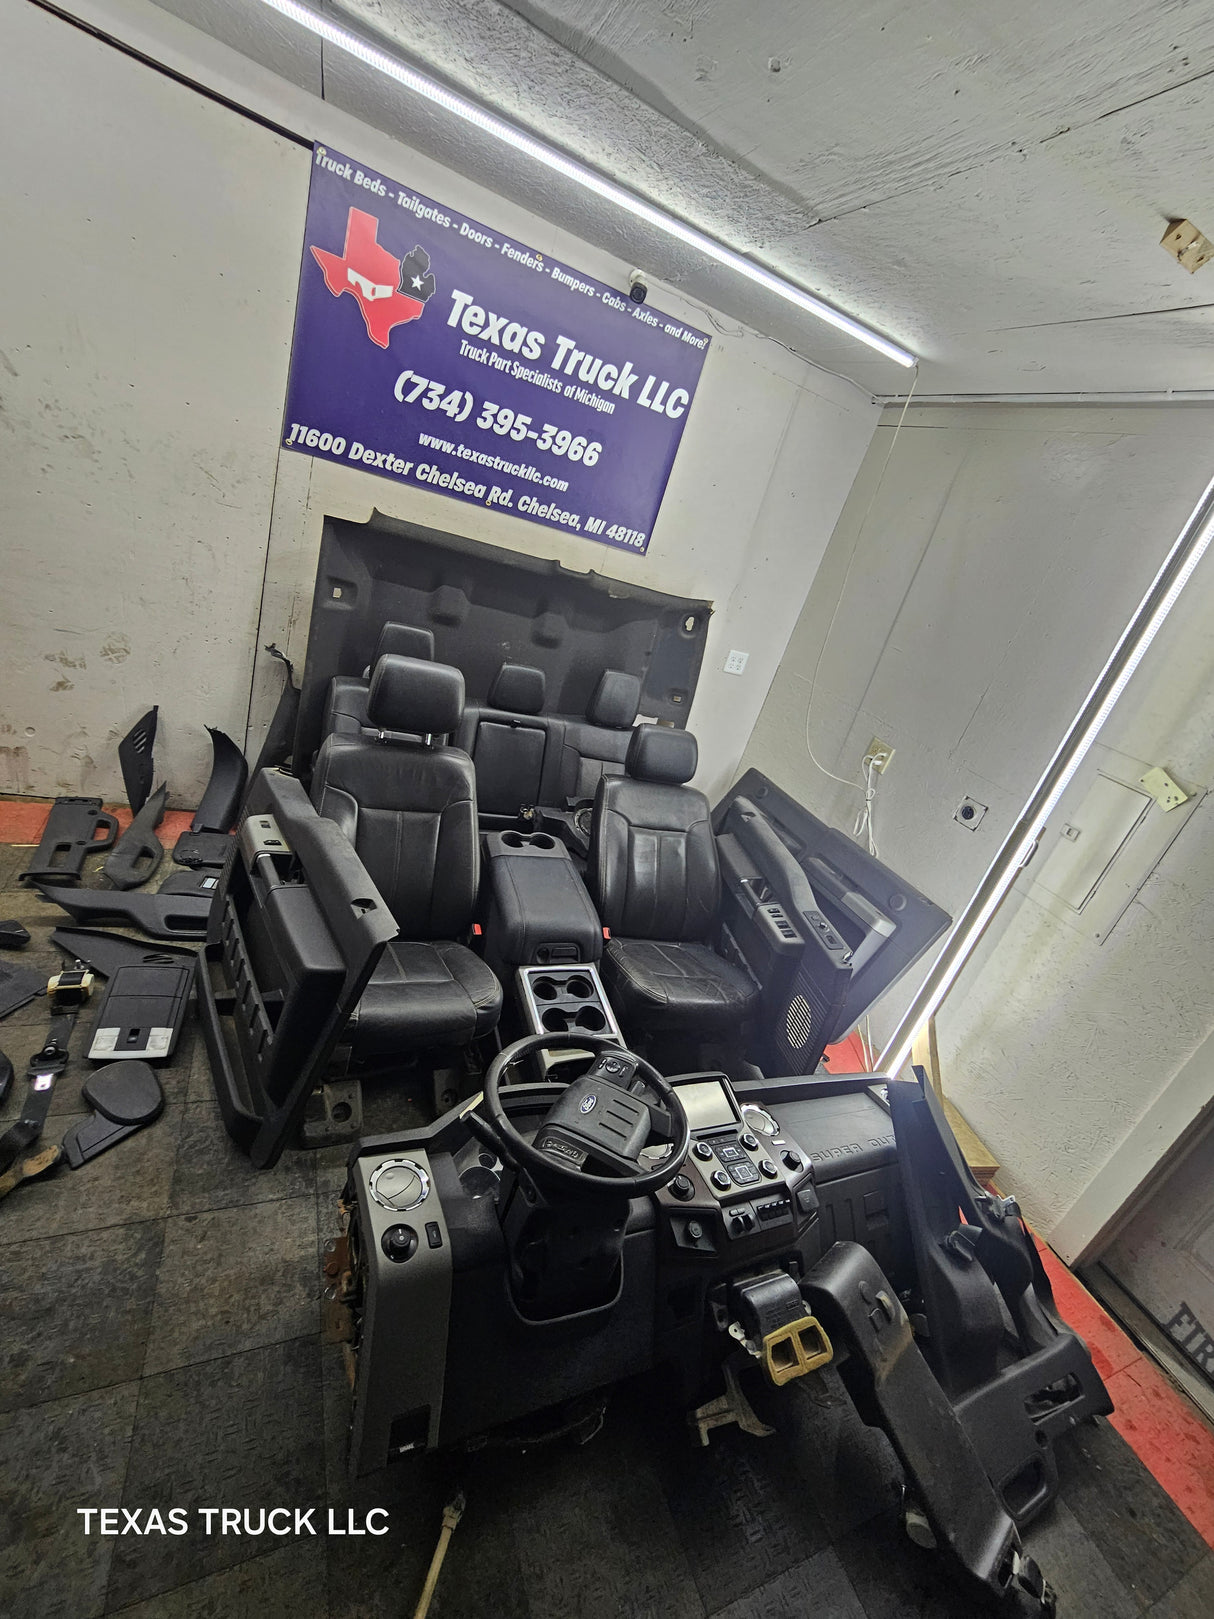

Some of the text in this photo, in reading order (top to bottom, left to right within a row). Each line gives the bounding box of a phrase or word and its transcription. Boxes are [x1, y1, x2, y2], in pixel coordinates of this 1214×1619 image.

[315, 151, 353, 181] Truck
[353, 170, 388, 197] Beds
[397, 191, 451, 228] Tailgates
[459, 222, 494, 248] Doors
[501, 242, 544, 272] Fenders
[551, 267, 595, 297] Bumpers
[601, 292, 627, 312] Cabs
[632, 307, 659, 327] Axles
[664, 323, 683, 339] and
[446, 288, 690, 420] Texas Truck LLC
[459, 339, 616, 415] Truck Part Specialists of Michigan
[393, 370, 603, 467] (734) 395-3966
[418, 432, 569, 492] www.texastruckllc.com
[289, 422, 647, 548] 11600 Dexter Chelsea Rd. Chelsea, MI 48118
[810, 1142, 864, 1161] SUPER
